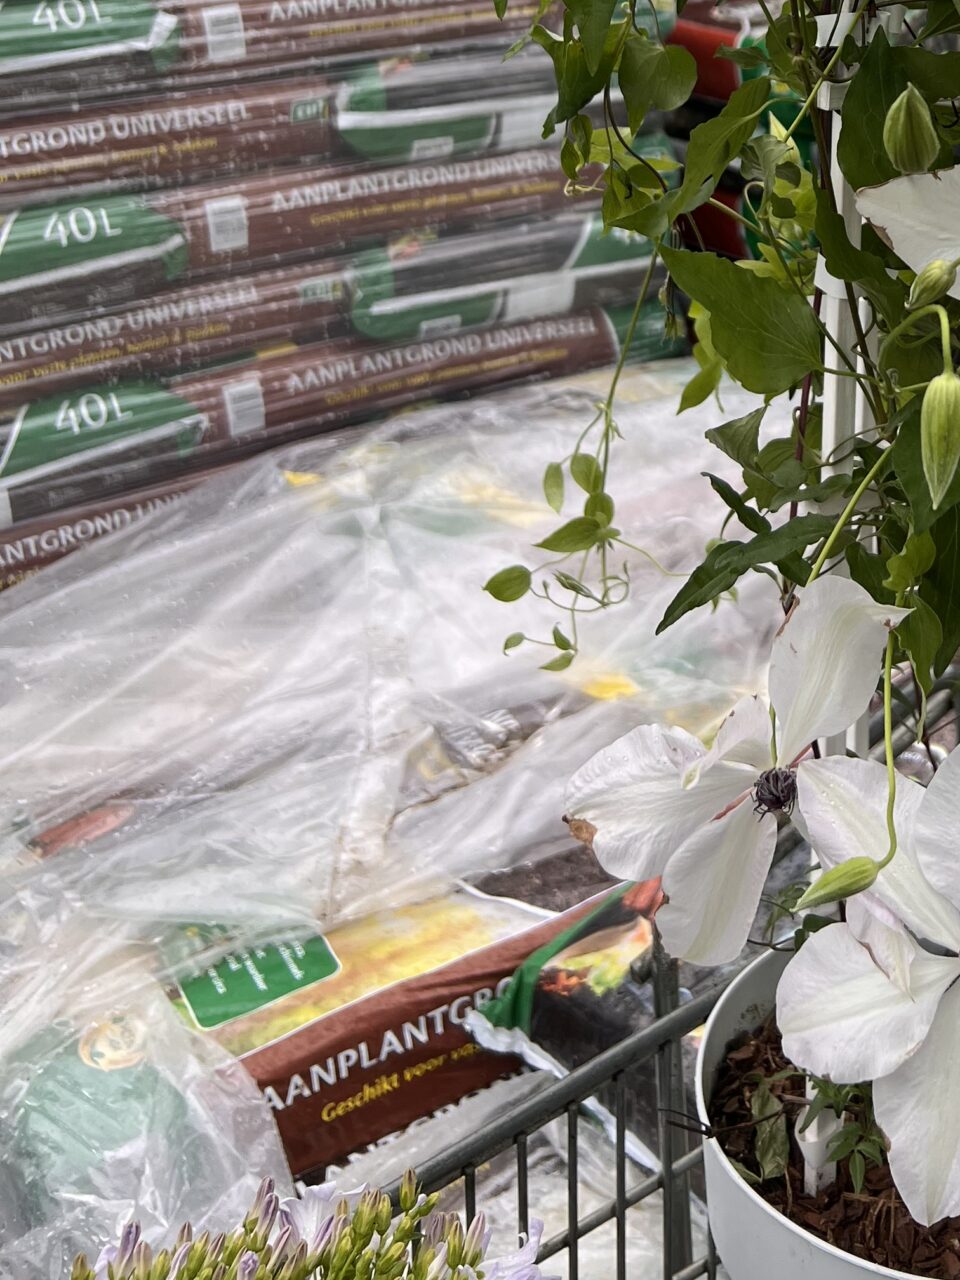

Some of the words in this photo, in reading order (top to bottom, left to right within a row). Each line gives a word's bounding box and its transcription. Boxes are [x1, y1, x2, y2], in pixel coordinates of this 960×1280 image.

[112, 101, 250, 139] UNIVERSEEL
[271, 165, 470, 212] AANPLANTGROND
[43, 207, 122, 247] 40L
[286, 334, 482, 395] AANPLANTGROND
[54, 392, 133, 435] 40L
[321, 1071, 400, 1122] Geschikt
[403, 1053, 447, 1081] voor
